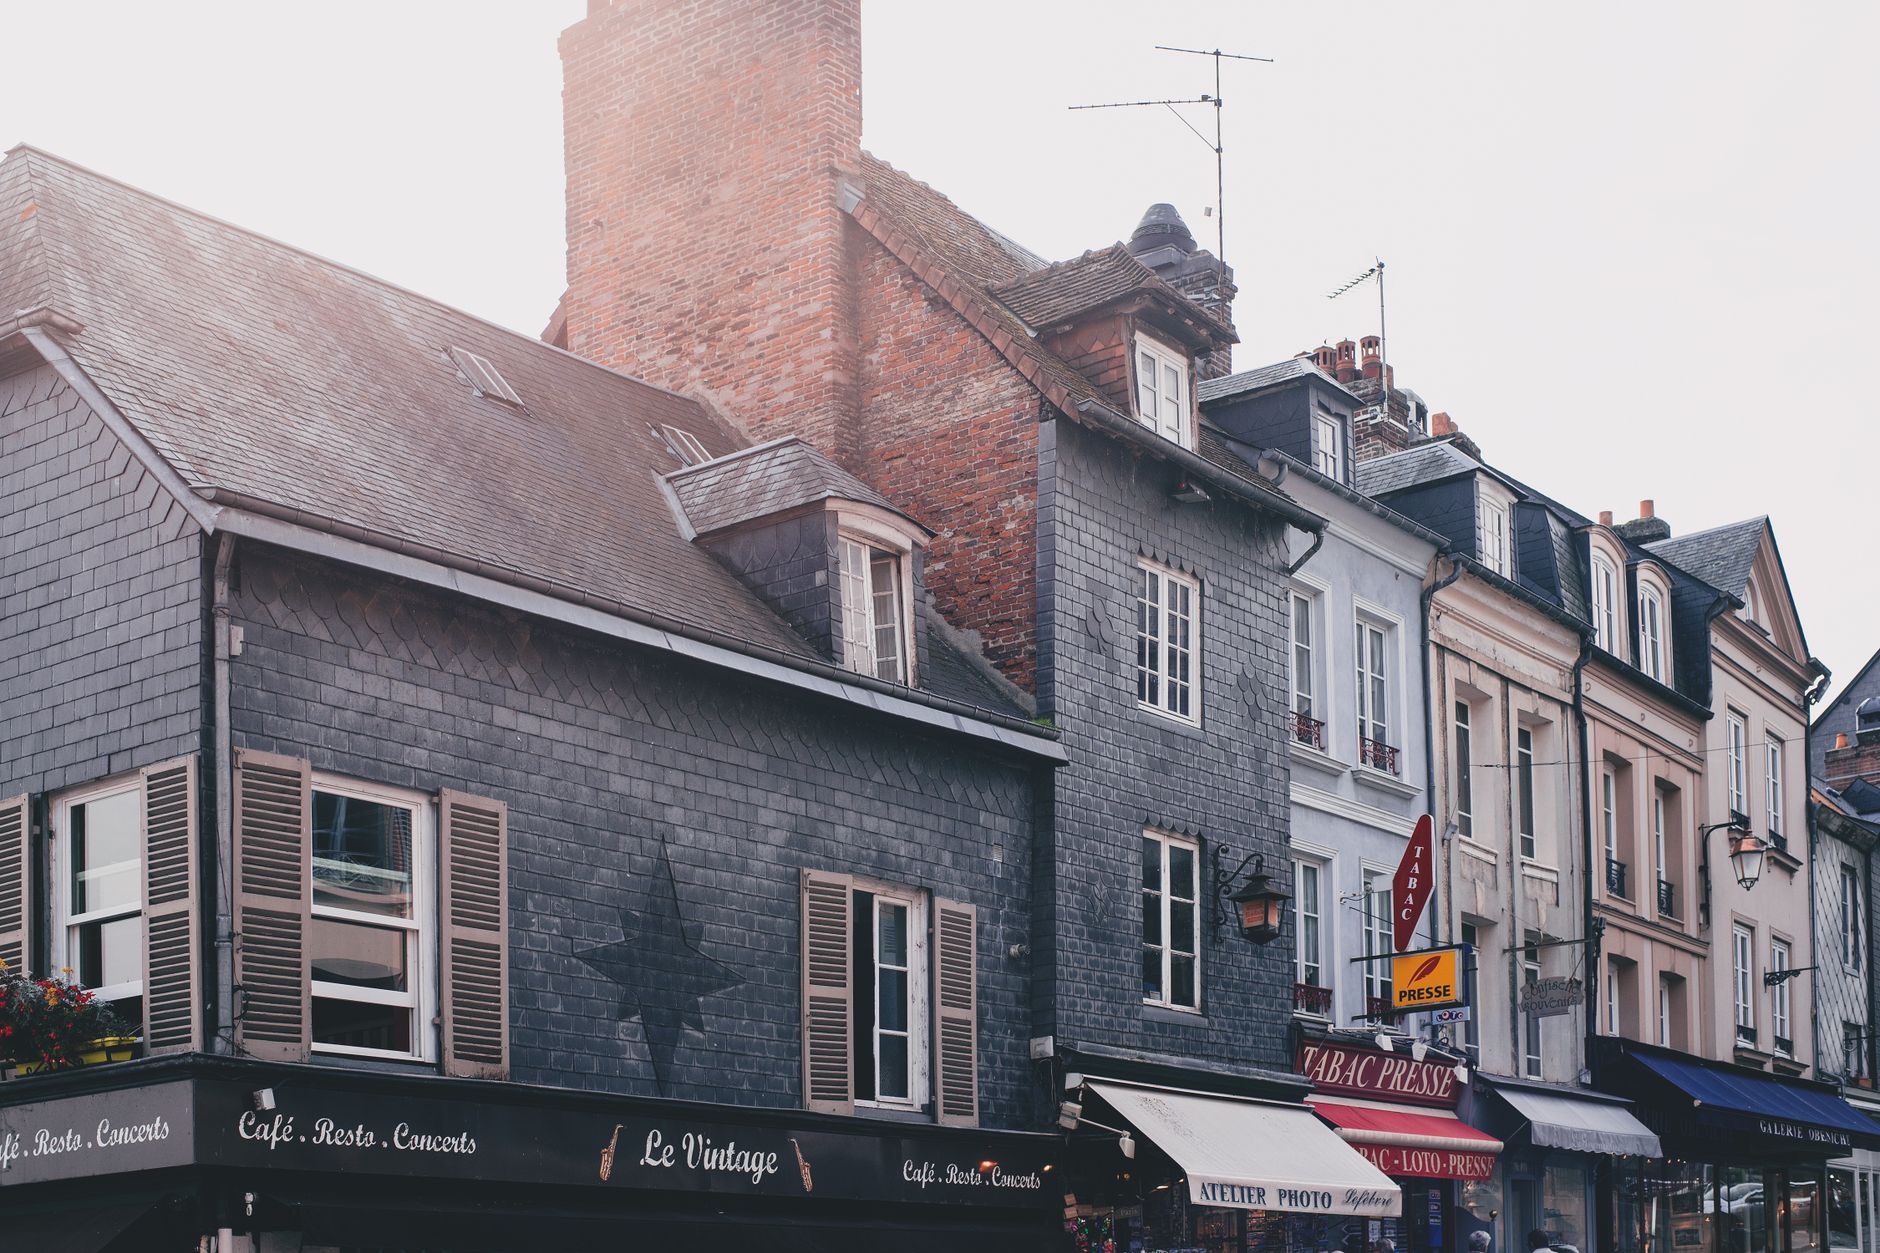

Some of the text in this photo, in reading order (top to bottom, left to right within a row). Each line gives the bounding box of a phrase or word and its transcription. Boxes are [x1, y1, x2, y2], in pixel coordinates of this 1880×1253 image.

[1401, 846, 1424, 921] TABAC
[1399, 984, 1451, 1002] PRESSE
[1436, 1010, 1464, 1023] LOTO
[1303, 1046, 1457, 1098] TABAC PRESSE
[33, 1128, 82, 1157] Resto
[97, 1116, 170, 1147] Concerts
[238, 1110, 477, 1154] Café Resto Concerts
[1760, 1119, 1803, 1139] GALERIE
[639, 1129, 779, 1185] Le Vintage
[1402, 1150, 1440, 1174] LOTO
[903, 1159, 1041, 1189] Café Resto Concerts
[1200, 1182, 1267, 1206] ATELIER
[1278, 1188, 1332, 1209] PHOTO
